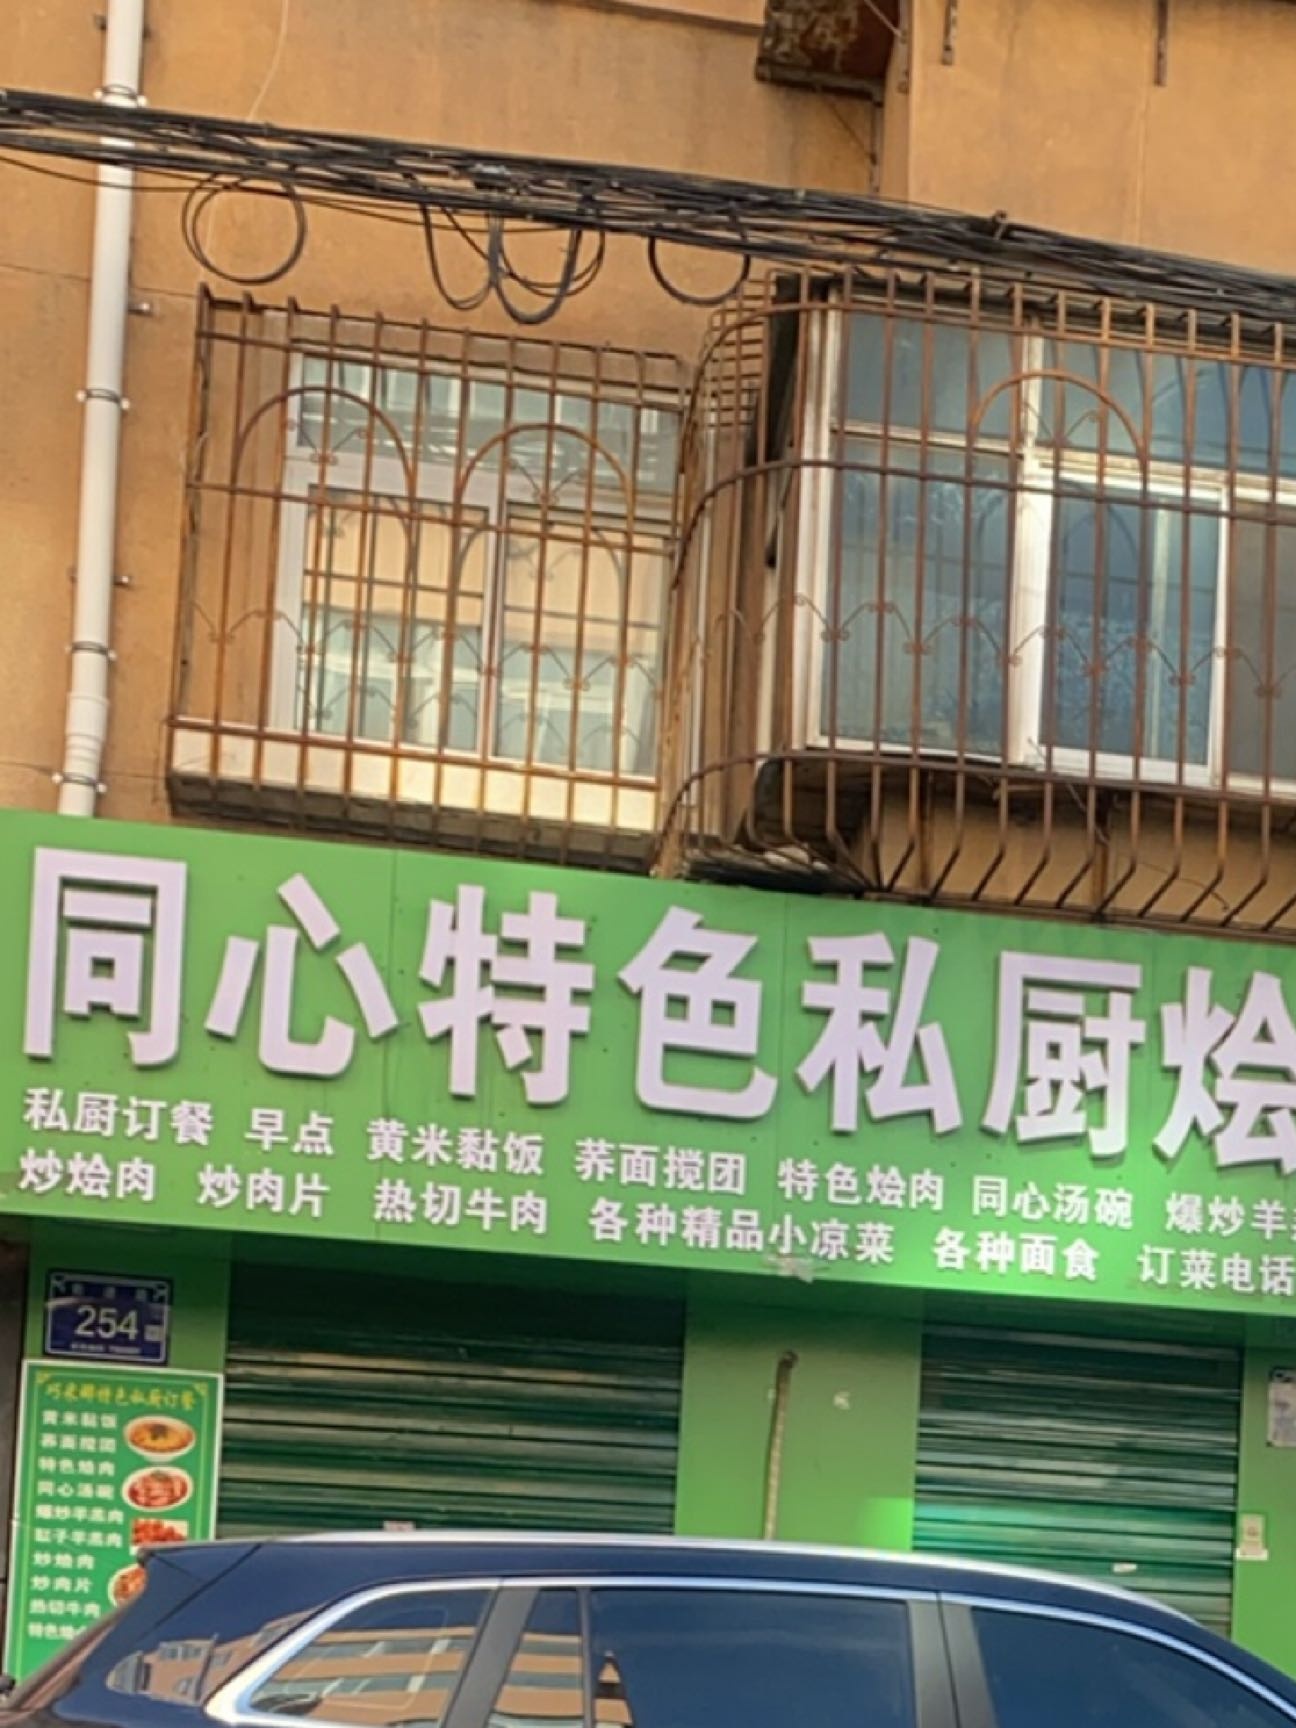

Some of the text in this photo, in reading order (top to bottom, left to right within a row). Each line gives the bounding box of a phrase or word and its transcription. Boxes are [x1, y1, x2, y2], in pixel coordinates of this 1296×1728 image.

[18, 1148, 156, 1201] 炒烩肉
[196, 1162, 330, 1218] 炒肉片
[373, 1178, 548, 1234] 热切牛肉
[588, 1196, 895, 1265] 各种精品小凉菜
[932, 1226, 1099, 1281] 各种面食
[23, 1087, 214, 1146] 私厨订餐
[244, 1108, 334, 1155] 早点
[366, 1117, 544, 1176] 黄米黏饭
[574, 1137, 747, 1196] 荞面搅团
[777, 1158, 945, 1211] 特色烩肉
[971, 1175, 1133, 1230] 同心汤碗
[74, 1304, 139, 1341] 254
